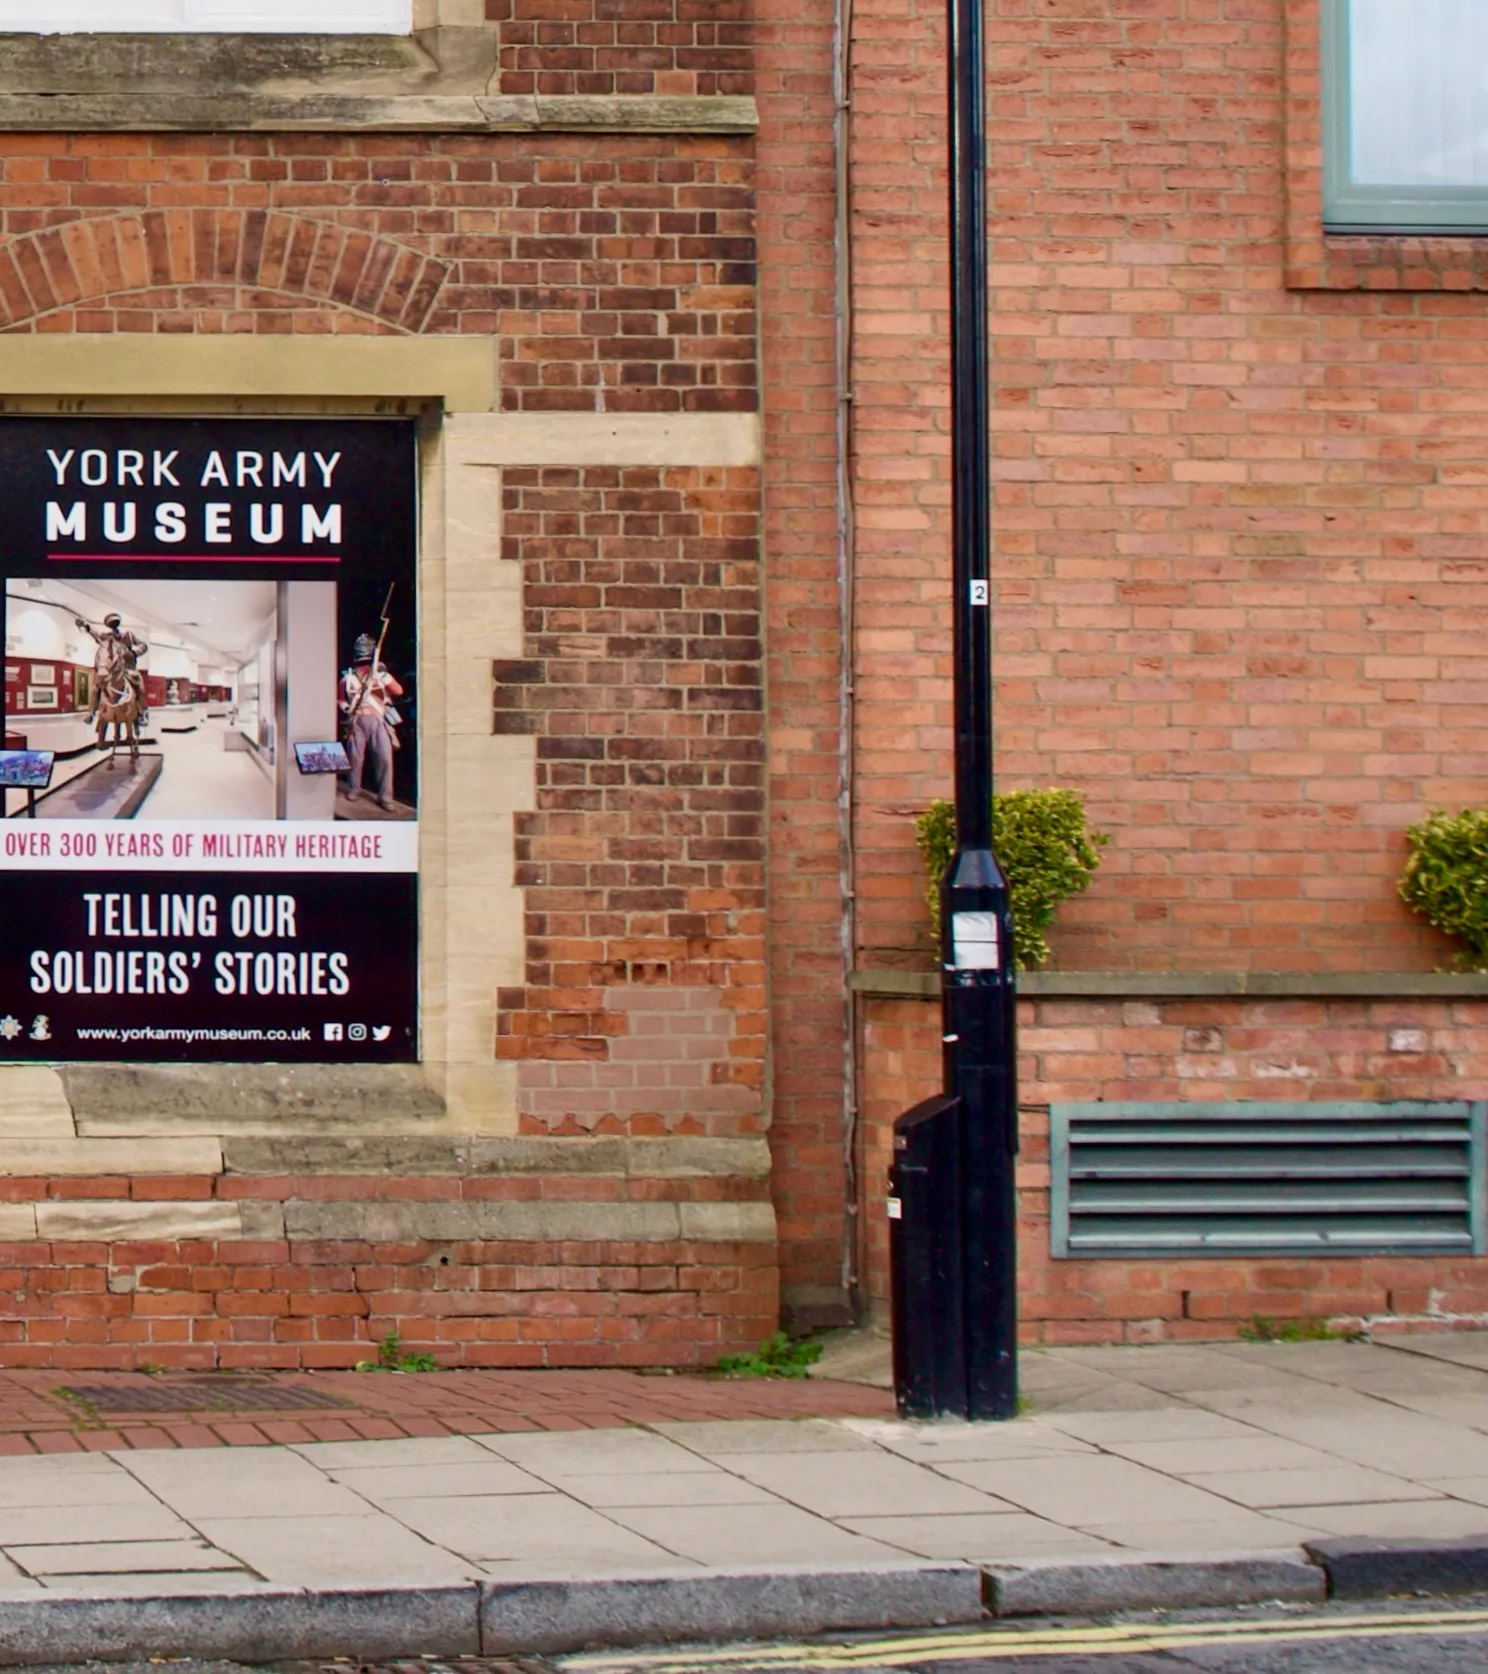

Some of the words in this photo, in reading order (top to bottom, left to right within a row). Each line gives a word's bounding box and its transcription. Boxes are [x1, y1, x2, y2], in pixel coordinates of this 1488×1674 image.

[46, 449, 180, 486] YORK
[200, 450, 342, 488] ARMY
[46, 501, 342, 544] MUSEUM
[975, 585, 985, 599] 2
[5, 833, 51, 857] OVER
[59, 833, 97, 857] 300
[105, 833, 164, 858] YEARS
[172, 834, 194, 858] OF
[203, 834, 287, 858] MILITARY
[296, 835, 383, 859] HERITAGE
[83, 893, 217, 937] TELLING
[231, 894, 297, 938] OUR
[29, 950, 201, 994] SOLDIERS'
[215, 952, 350, 995] STORIES
[77, 1026, 311, 1043] www.yorkarmymuseum.co.uk
